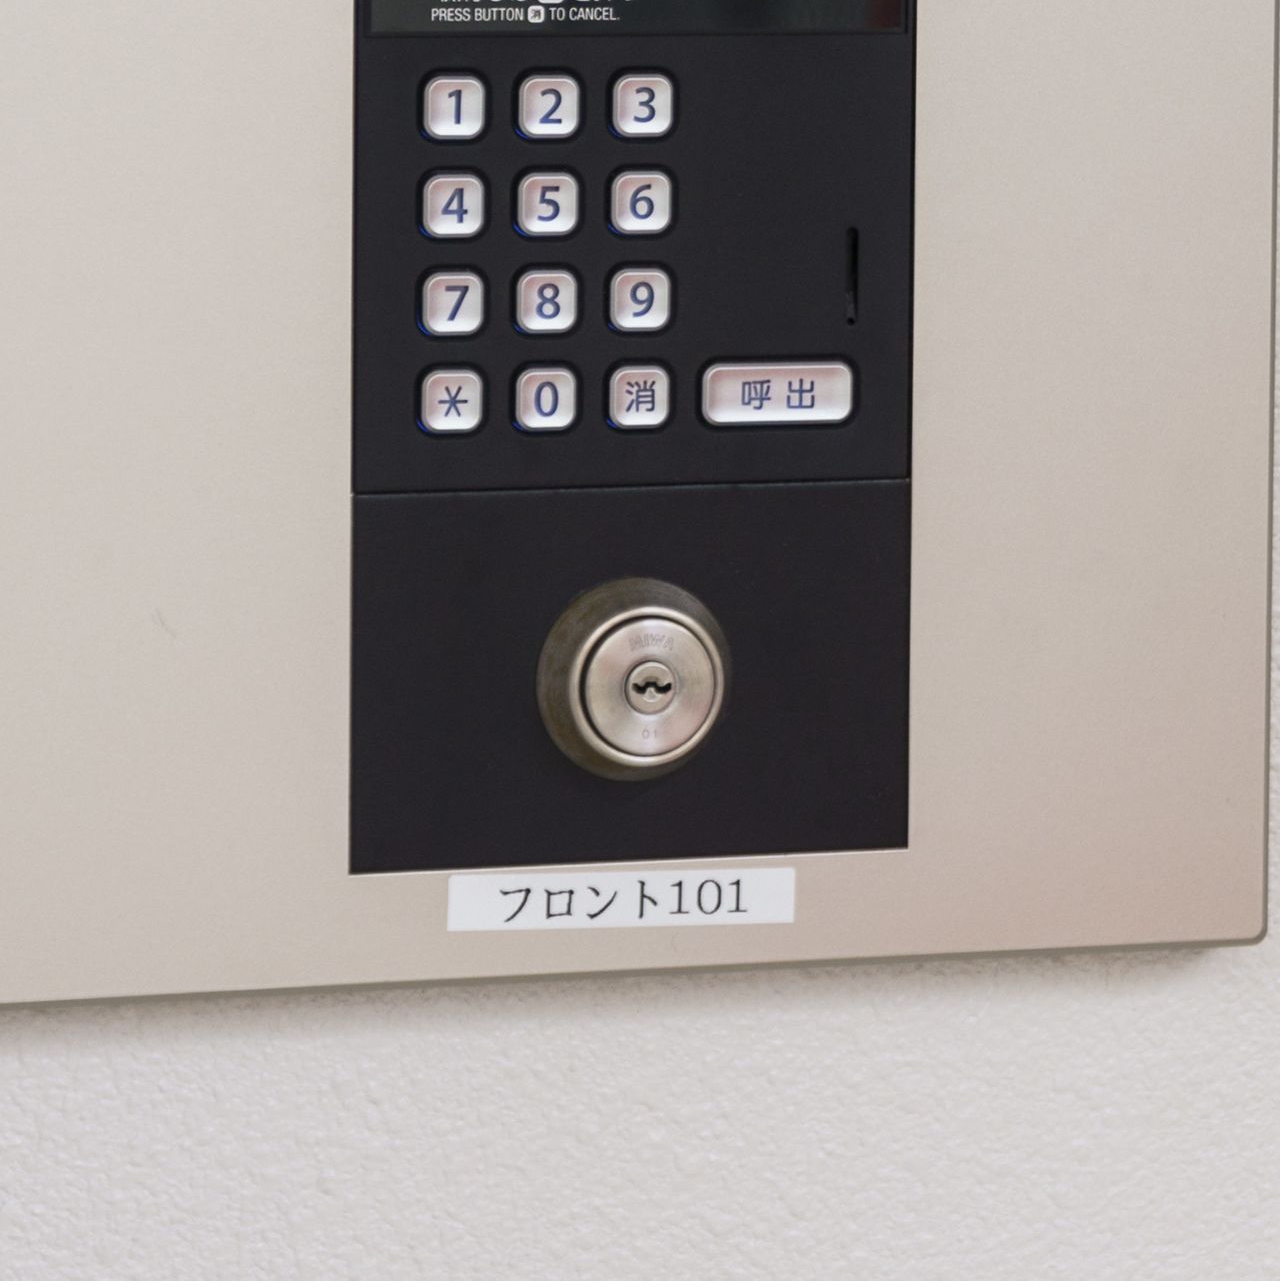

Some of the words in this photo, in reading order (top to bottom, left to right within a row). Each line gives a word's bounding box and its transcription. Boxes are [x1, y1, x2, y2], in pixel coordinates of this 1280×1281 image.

[431, 7, 472, 22] PRESS
[474, 7, 525, 22] BUTTON
[548, 7, 567, 22] TO
[568, 6, 620, 22] CANCEL.
[447, 88, 463, 125] 1
[539, 87, 563, 124] 2
[633, 86, 656, 123] 3
[441, 187, 469, 224] 4
[537, 185, 561, 222] 5
[629, 182, 655, 220] 6
[444, 284, 470, 321] 7
[535, 282, 561, 319] 8
[629, 280, 655, 317] 9
[534, 380, 559, 417] 0
[625, 379, 657, 413] 消
[741, 377, 816, 411] 呼出
[499, 878, 749, 923] フロント101
